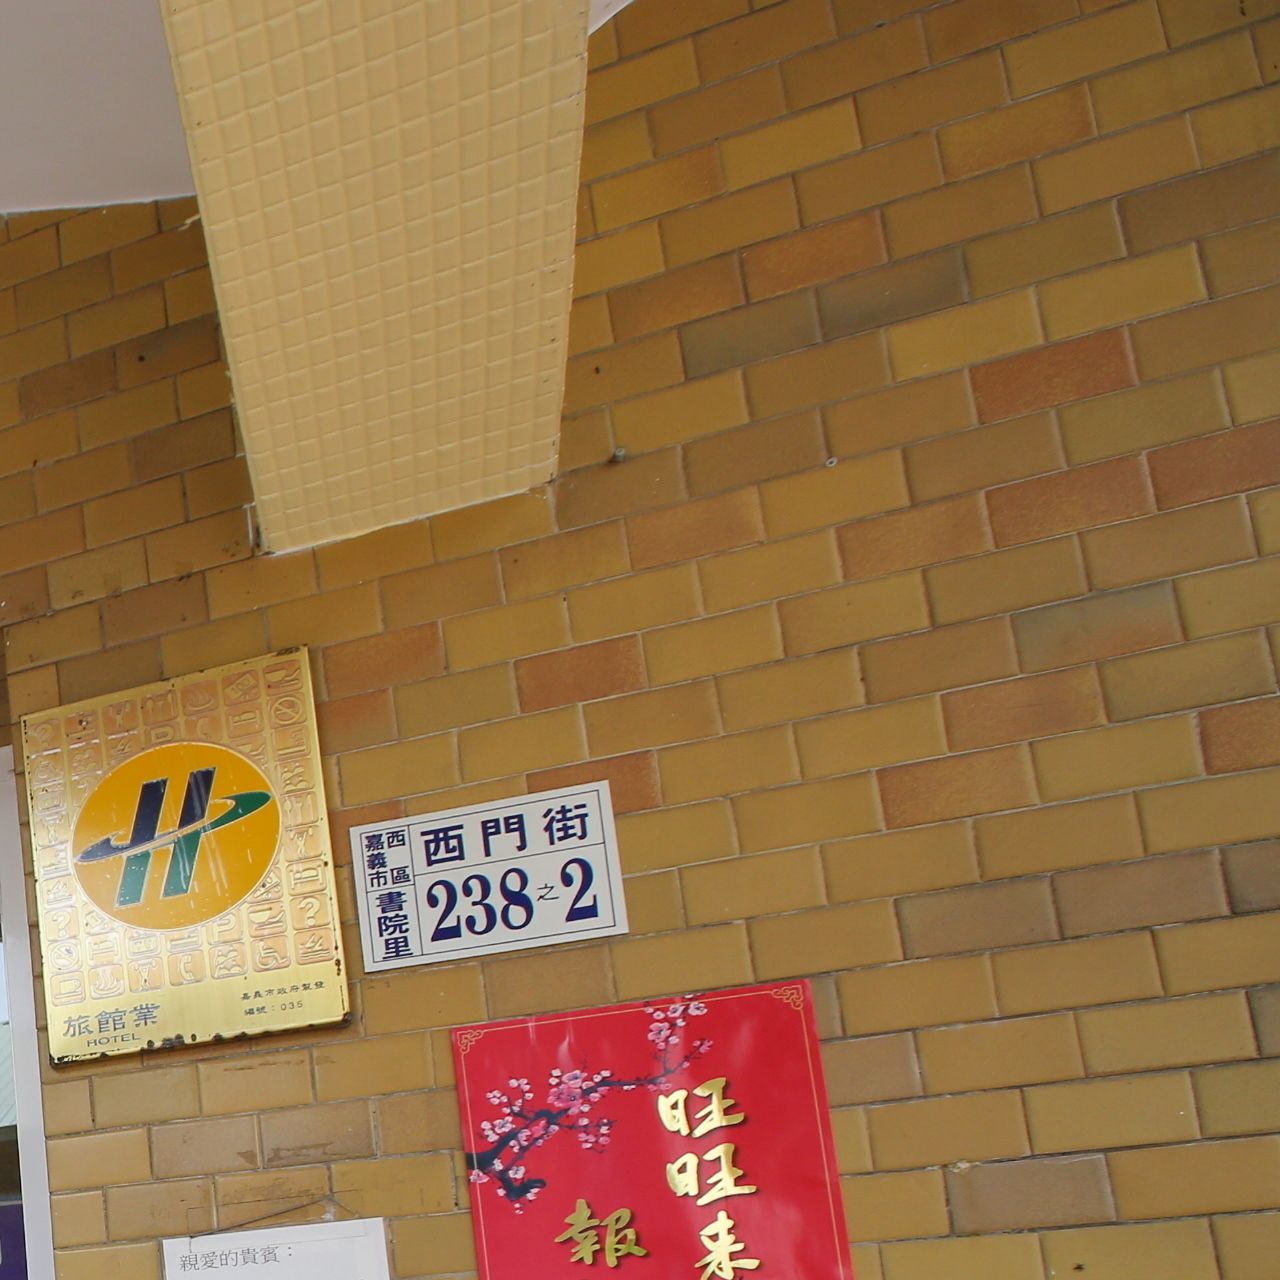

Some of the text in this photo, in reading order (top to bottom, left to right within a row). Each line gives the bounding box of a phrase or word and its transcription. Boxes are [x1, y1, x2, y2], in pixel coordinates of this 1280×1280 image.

[364, 833, 388, 888] 嘉義市
[419, 802, 590, 868] 西門街
[375, 890, 414, 961] 書院里
[425, 856, 600, 943] 238之2
[62, 1002, 162, 1038] 旅館業
[86, 1032, 142, 1048] HOTEL
[179, 1244, 294, 1273] 親愛的貴賓：
